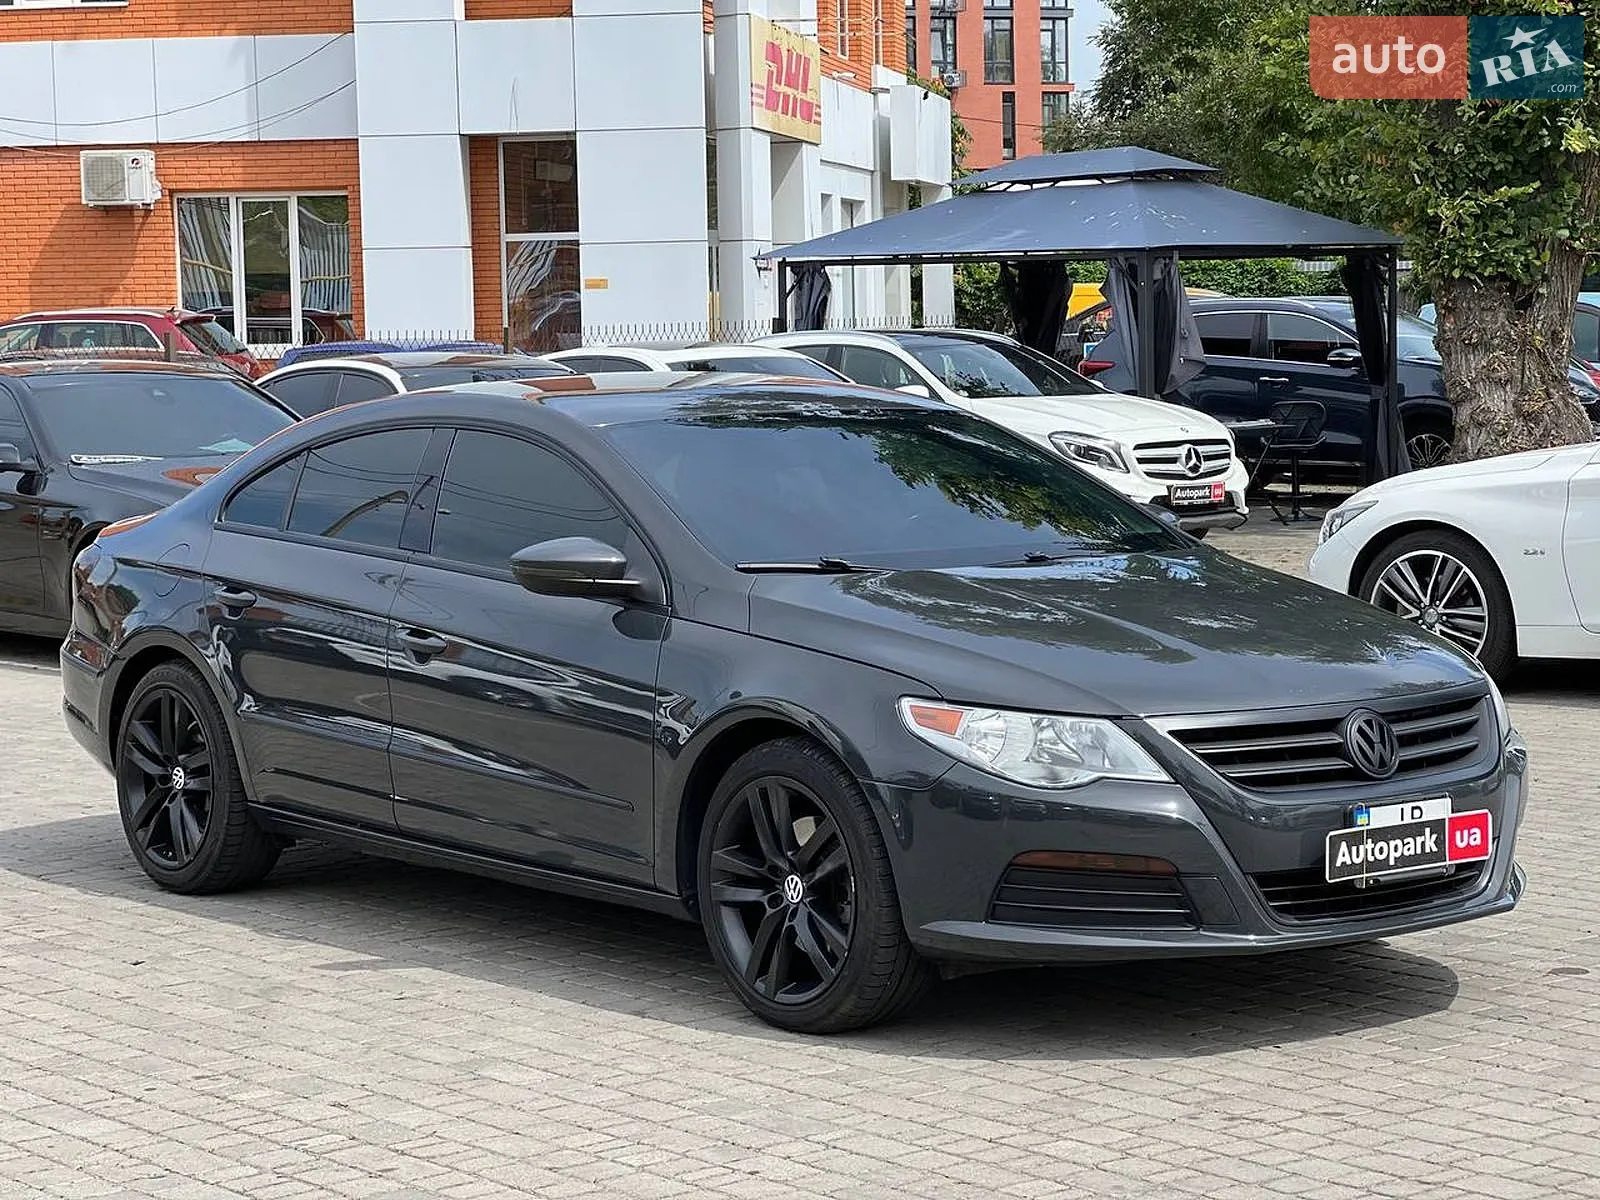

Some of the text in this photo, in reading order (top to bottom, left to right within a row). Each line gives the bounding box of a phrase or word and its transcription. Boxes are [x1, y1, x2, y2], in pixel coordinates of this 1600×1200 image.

[764, 40, 812, 123] DHL
[1175, 486, 1211, 499] Autopark
[1335, 826, 1482, 867] Autopark ua
